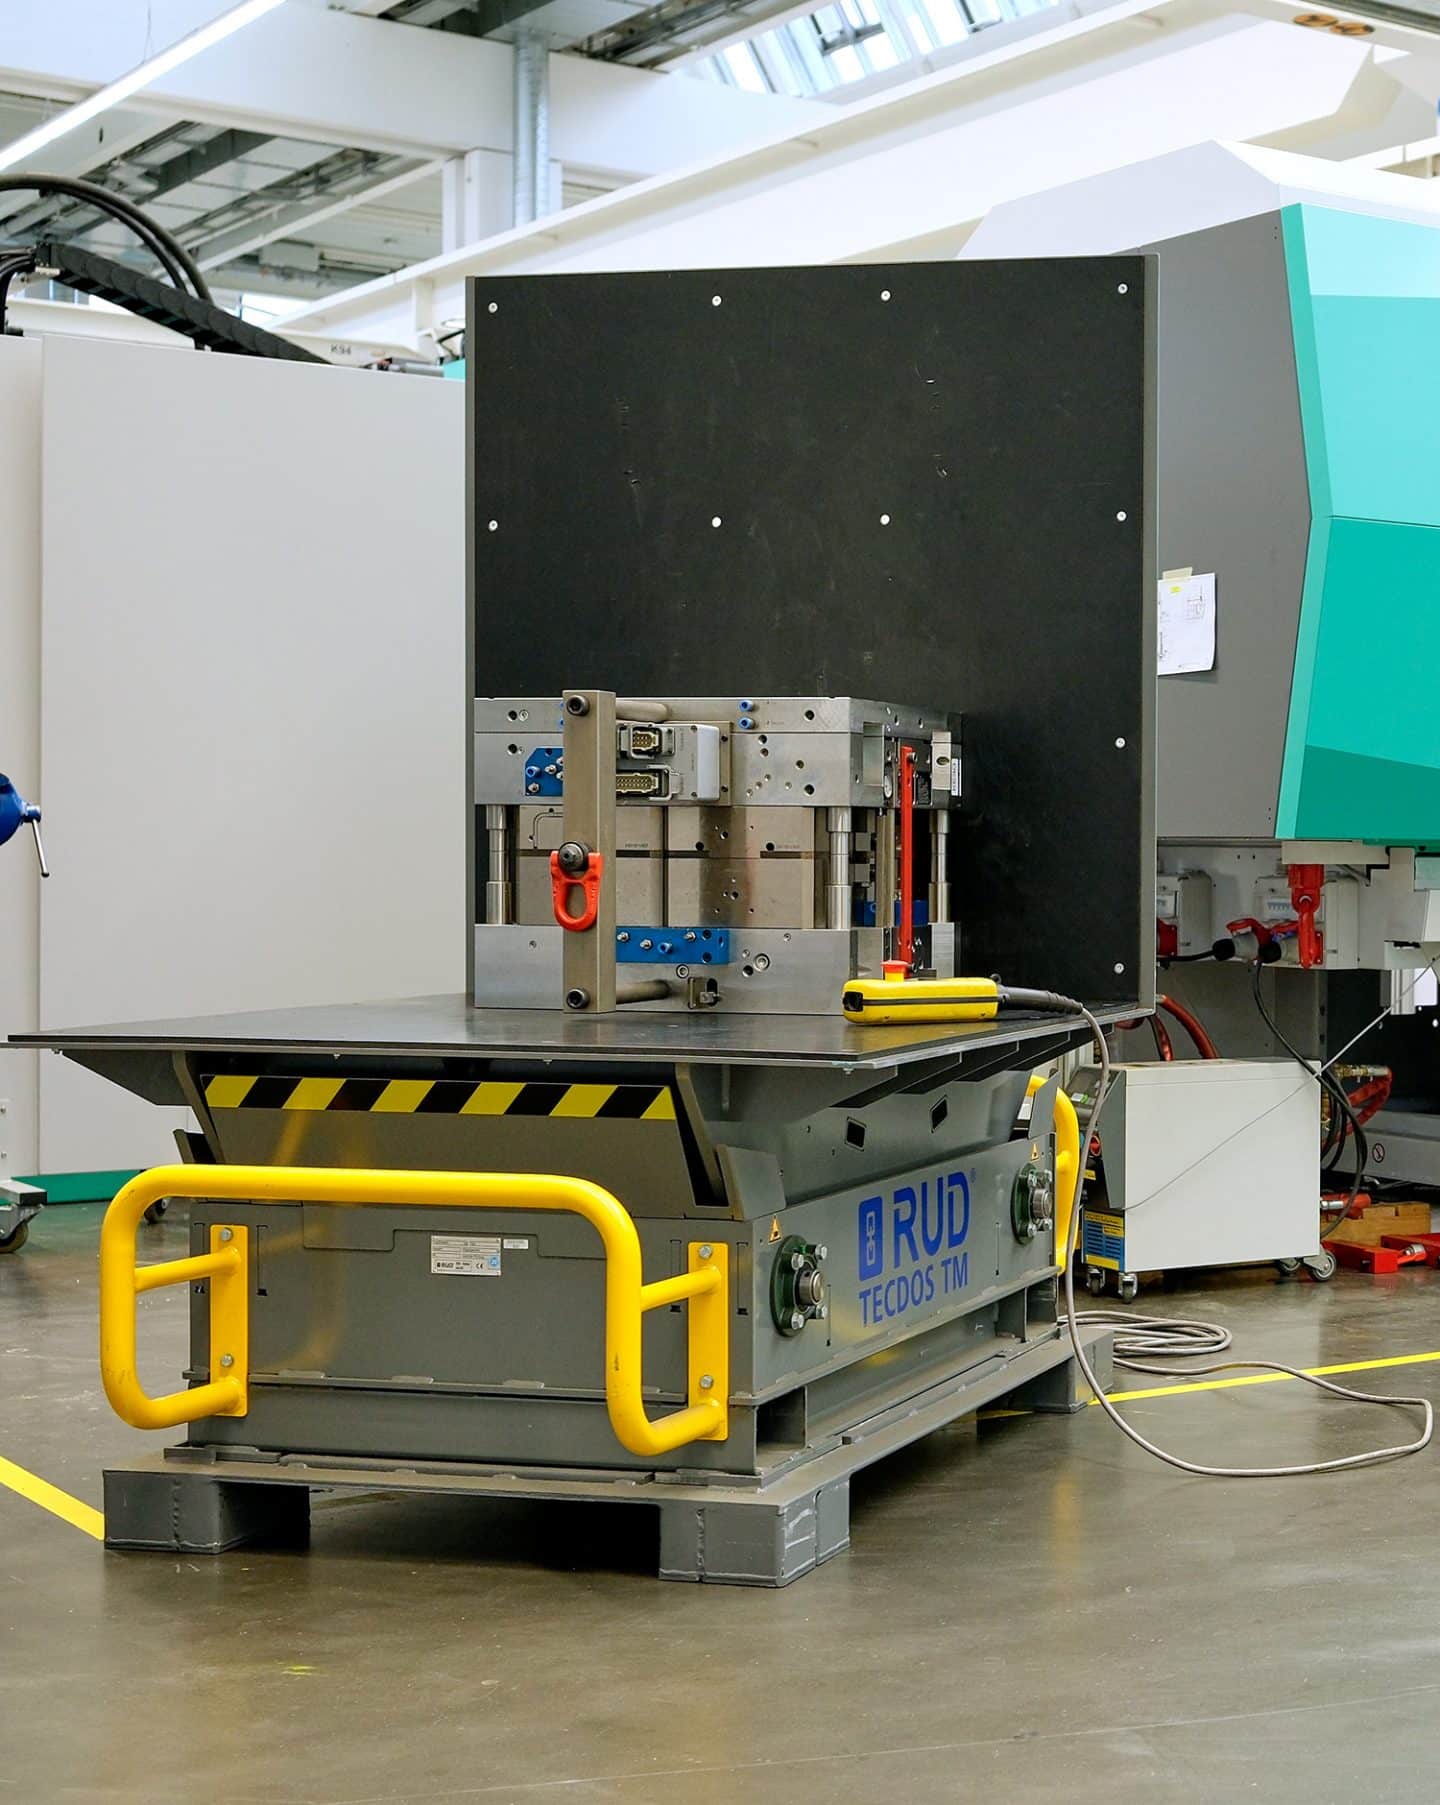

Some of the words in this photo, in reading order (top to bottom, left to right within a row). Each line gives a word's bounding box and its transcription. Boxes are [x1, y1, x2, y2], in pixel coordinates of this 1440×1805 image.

[893, 1171, 970, 1269] RUD
[859, 1264, 935, 1328] TECDOS
[941, 1252, 969, 1294] TM
